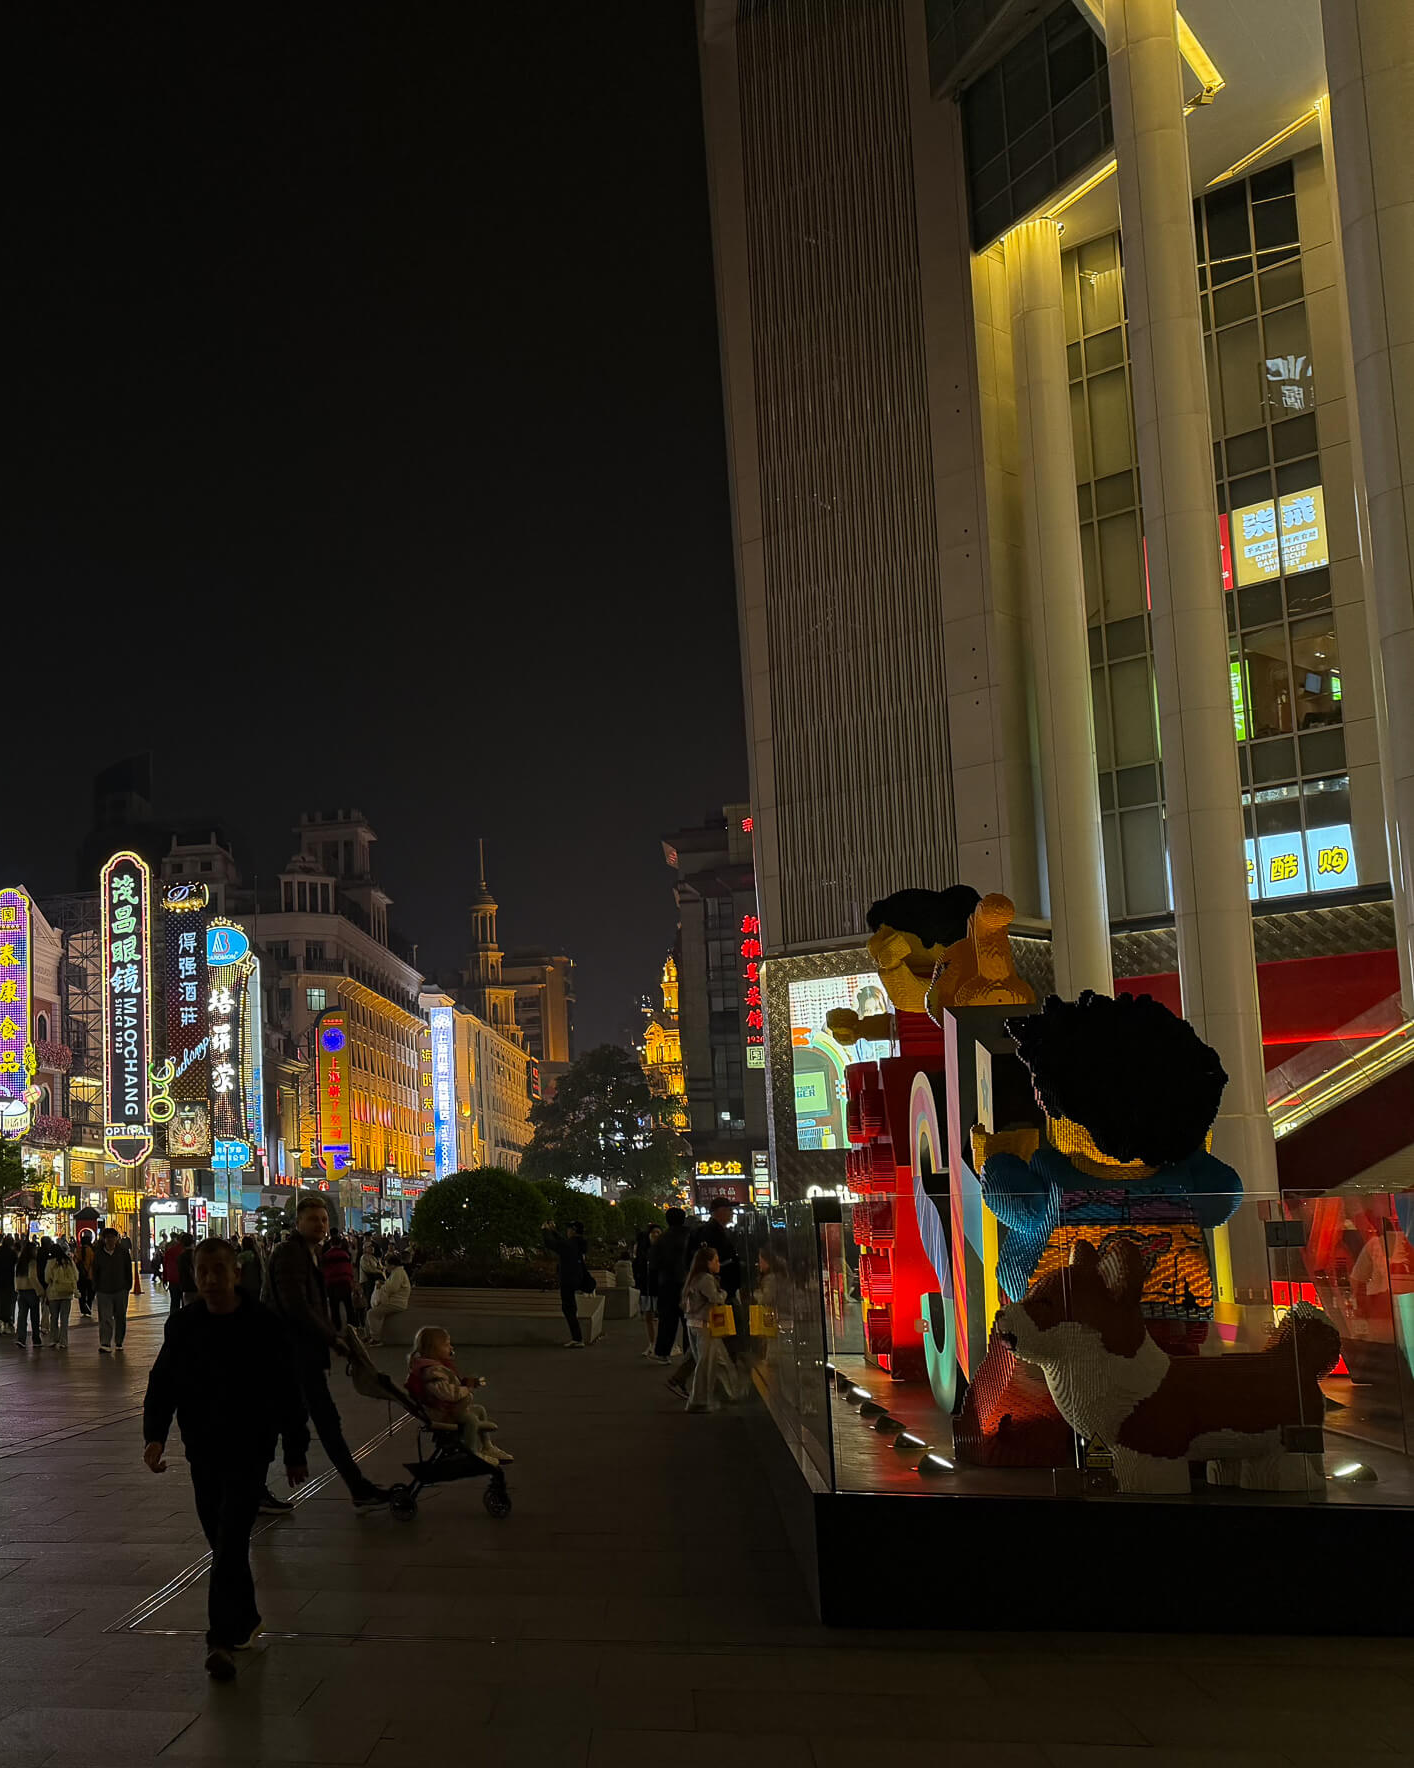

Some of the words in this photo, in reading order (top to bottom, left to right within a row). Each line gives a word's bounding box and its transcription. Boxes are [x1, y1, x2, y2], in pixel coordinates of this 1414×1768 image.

[111, 874, 142, 994] 茂昌眼镜
[114, 998, 123, 1027] SINCE
[115, 1031, 123, 1054] 1923
